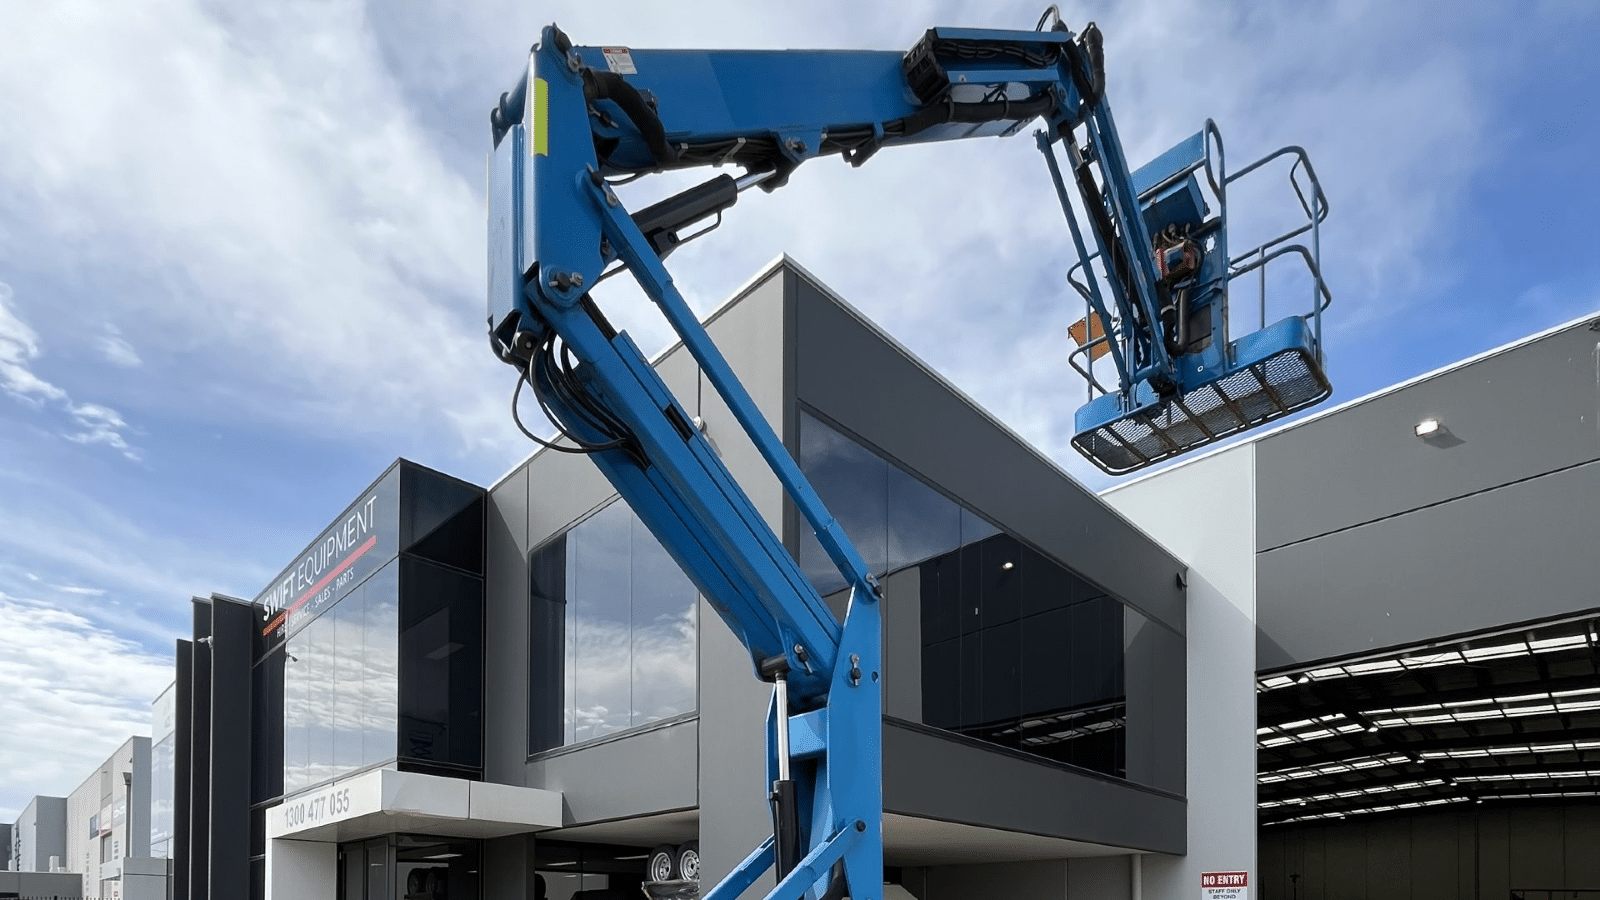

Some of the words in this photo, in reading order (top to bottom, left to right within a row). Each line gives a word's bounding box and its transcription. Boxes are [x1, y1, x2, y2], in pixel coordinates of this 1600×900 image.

[263, 571, 296, 621] SWIFT
[298, 495, 377, 591] EQUIPMENT
[315, 586, 330, 608] SALES
[336, 566, 354, 591] PARTS
[285, 803, 305, 828] 1300
[308, 796, 326, 821] 477
[330, 788, 349, 815] 055
[1203, 875, 1215, 886] NO
[1217, 874, 1245, 885] ENTRY
